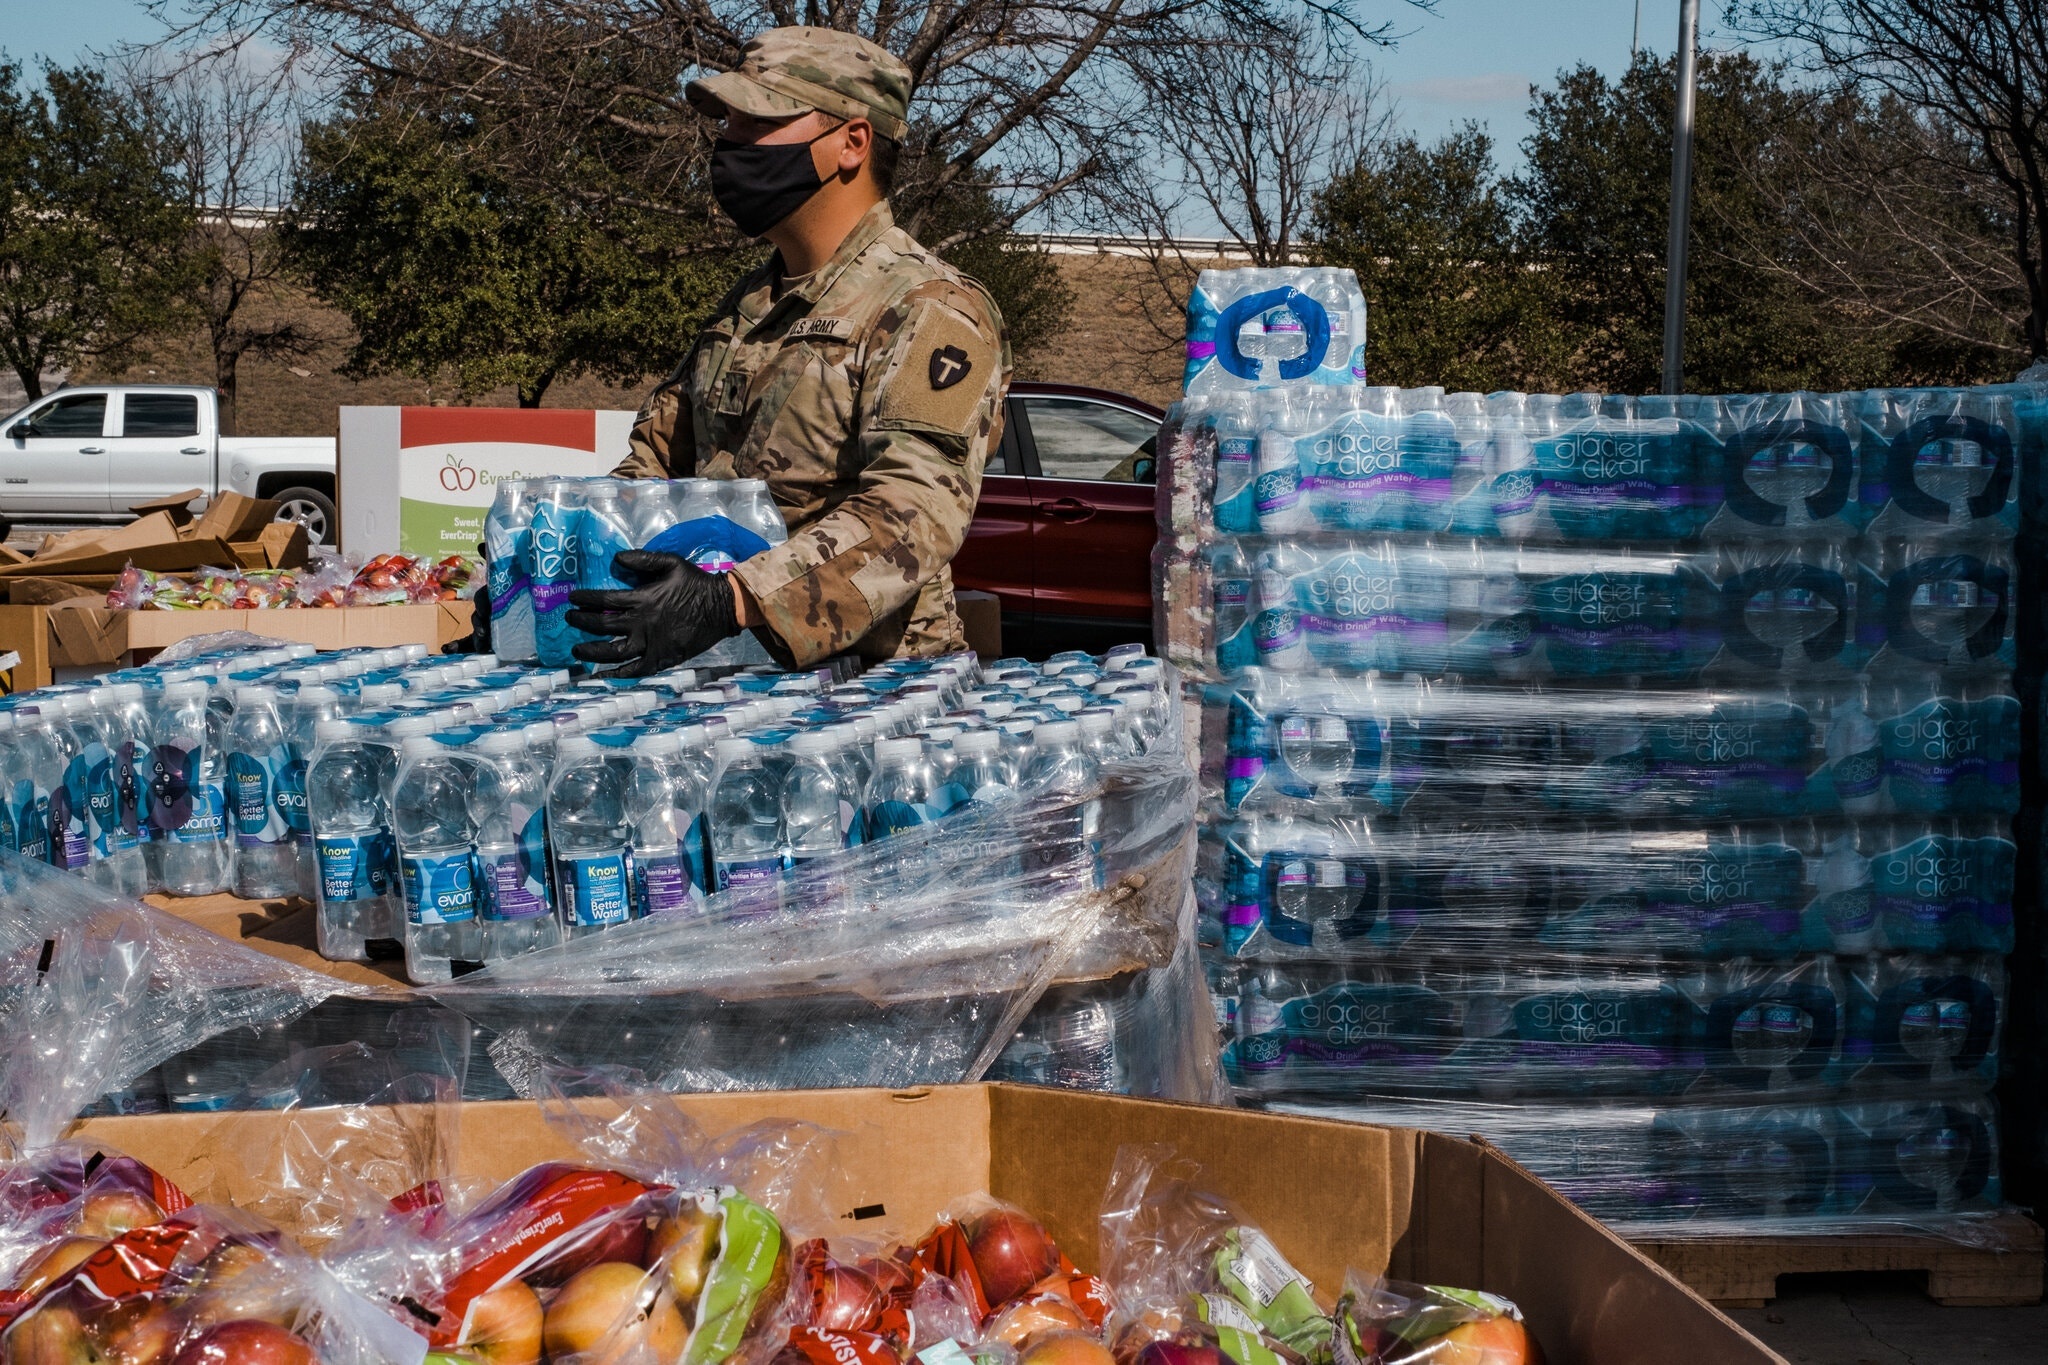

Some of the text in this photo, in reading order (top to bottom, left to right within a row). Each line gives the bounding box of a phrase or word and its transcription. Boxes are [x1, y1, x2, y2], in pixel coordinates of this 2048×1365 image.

[790, 319, 840, 335] U.S. ARMY
[1313, 430, 1406, 465] glacier
[1555, 434, 1650, 469] glacier
[1339, 451, 1408, 476] clear
[1583, 457, 1651, 479] clear
[1257, 474, 1296, 498] glacier
[1314, 474, 1413, 489] Purified Drinking Water
[1554, 482, 1590, 494] Purified
[1627, 480, 1657, 492] Water
[533, 583, 568, 598] Drinking
[1311, 572, 1400, 605] glacier
[1552, 578, 1645, 611] glacier
[1336, 594, 1400, 616] clear
[1580, 602, 1647, 624] clear
[1310, 615, 1408, 631] Purified Drinking Water
[1666, 718, 1759, 749] glacier
[1694, 739, 1761, 762] clear
[1924, 735, 1982, 760] clear
[1738, 763, 1767, 772] Water
[239, 805, 265, 814] Better
[240, 813, 265, 821] Water
[322, 845, 351, 856] Know
[940, 841, 999, 860] evamo
[588, 865, 618, 877] Know
[325, 879, 353, 888] Better
[327, 887, 354, 897] Water
[1688, 880, 1753, 904] clear
[1916, 873, 1973, 897] clear
[591, 900, 621, 911] Better
[592, 909, 622, 920] Water
[1300, 998, 1393, 1028] glacier
[1531, 998, 1627, 1028] glacier
[1327, 1021, 1393, 1045] clear
[1560, 1018, 1627, 1043] clear
[1265, 1255, 1291, 1282] Calories
